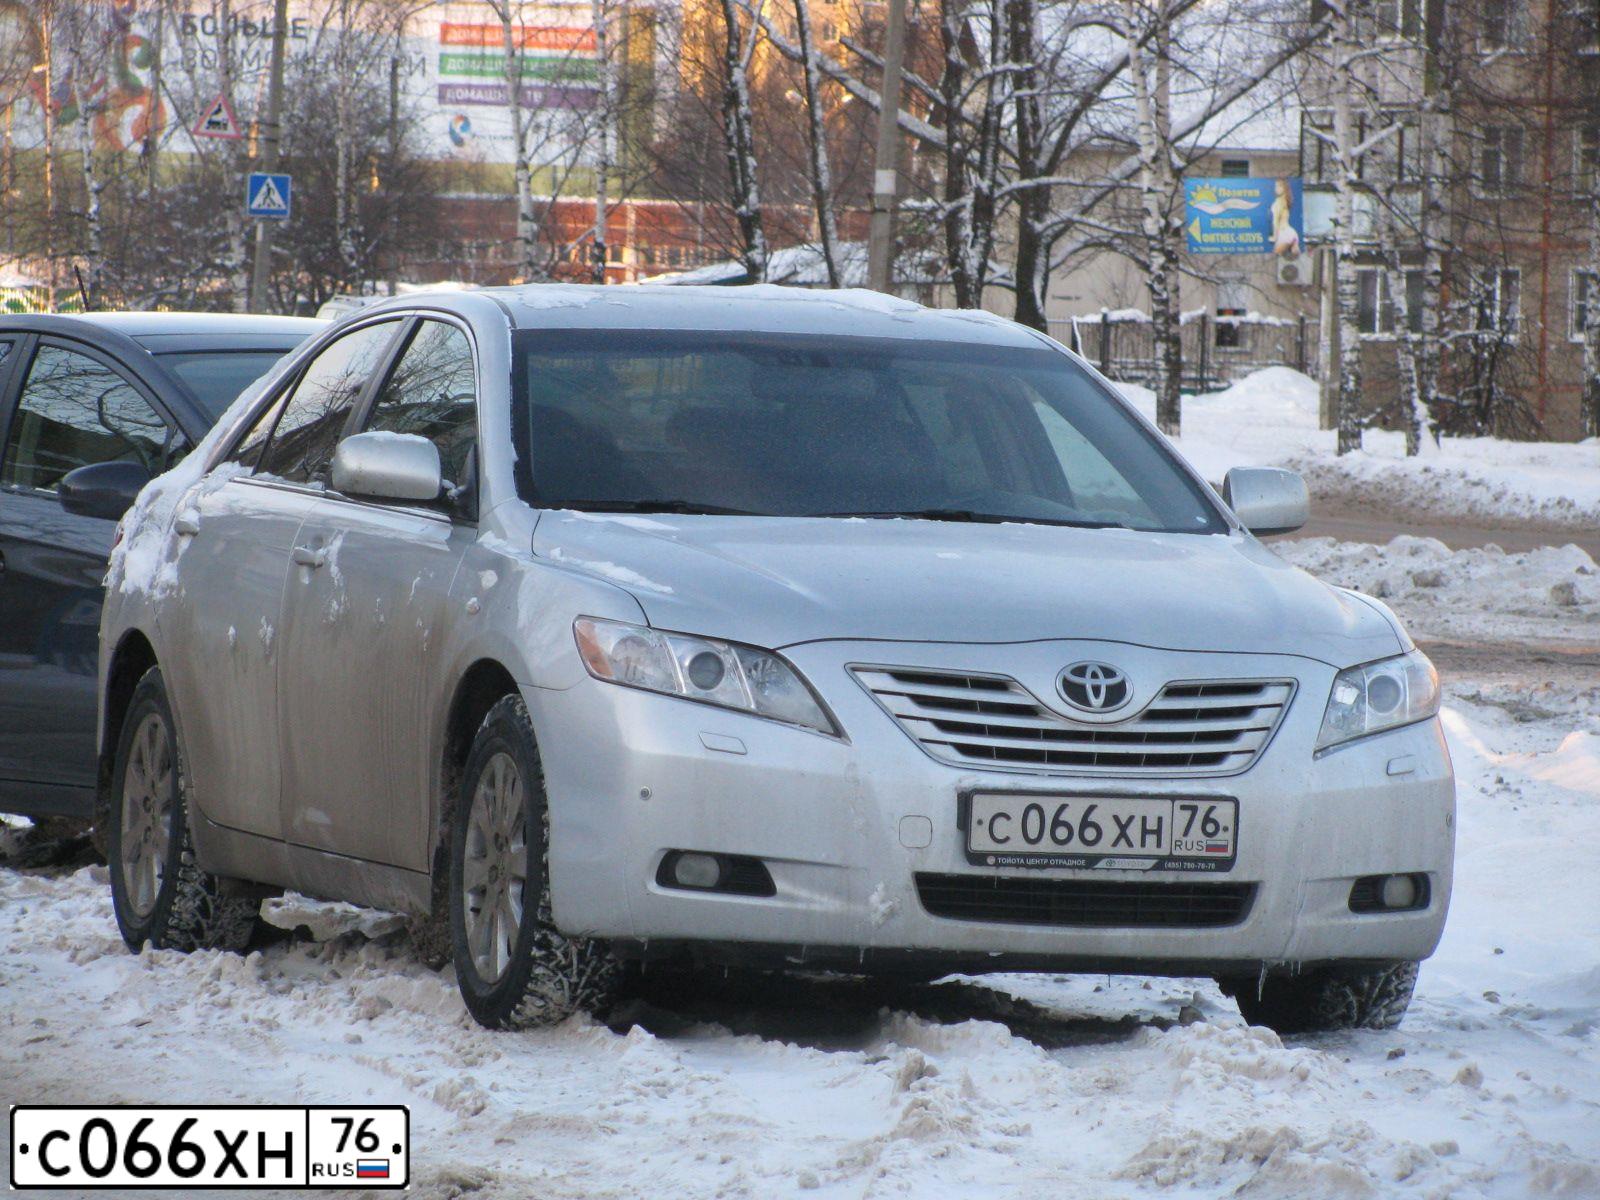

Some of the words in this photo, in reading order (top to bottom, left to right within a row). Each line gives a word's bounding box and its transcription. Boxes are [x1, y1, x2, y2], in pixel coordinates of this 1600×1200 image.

[1180, 804, 1220, 838] 76
[1174, 840, 1204, 852] RUS
[997, 857, 1025, 865] ТОЙОТА
[1026, 858, 1048, 866] ЦЕНТР
